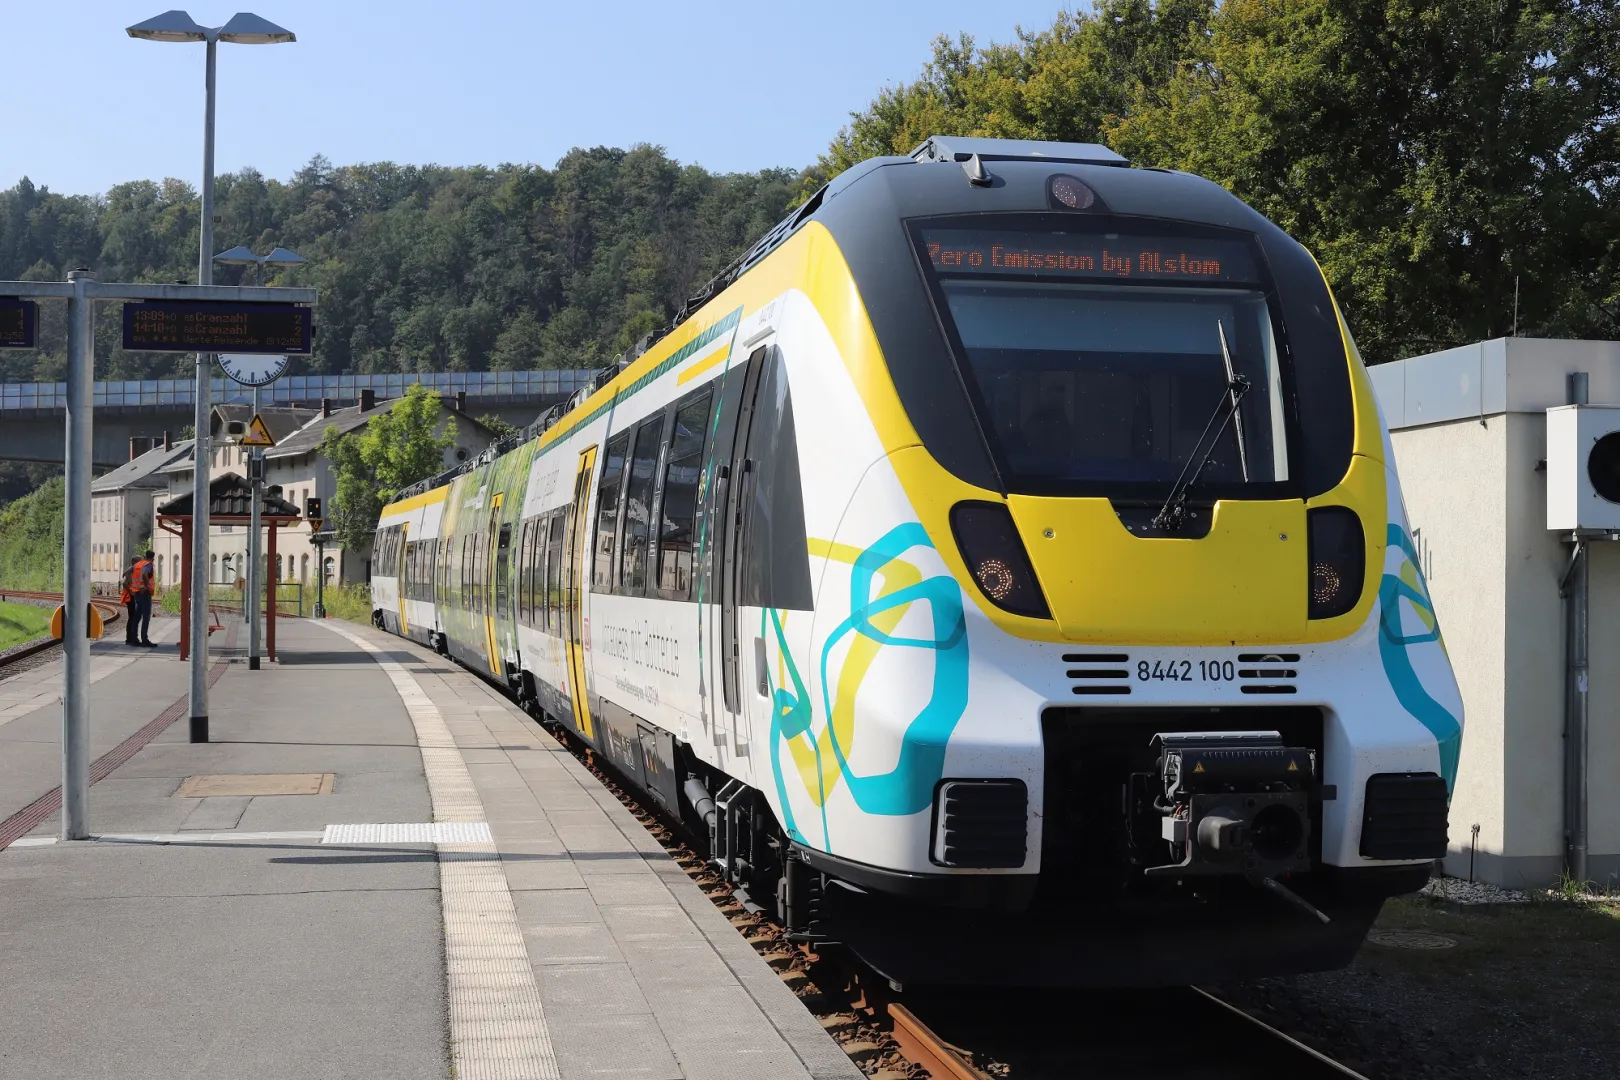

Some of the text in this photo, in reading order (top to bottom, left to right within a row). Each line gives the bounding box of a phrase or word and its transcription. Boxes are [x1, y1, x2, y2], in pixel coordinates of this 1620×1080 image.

[926, 243, 1220, 275] Zero Emission by Alstom
[195, 311, 248, 323] Cranzahl
[1137, 660, 1235, 681] 8442 100
